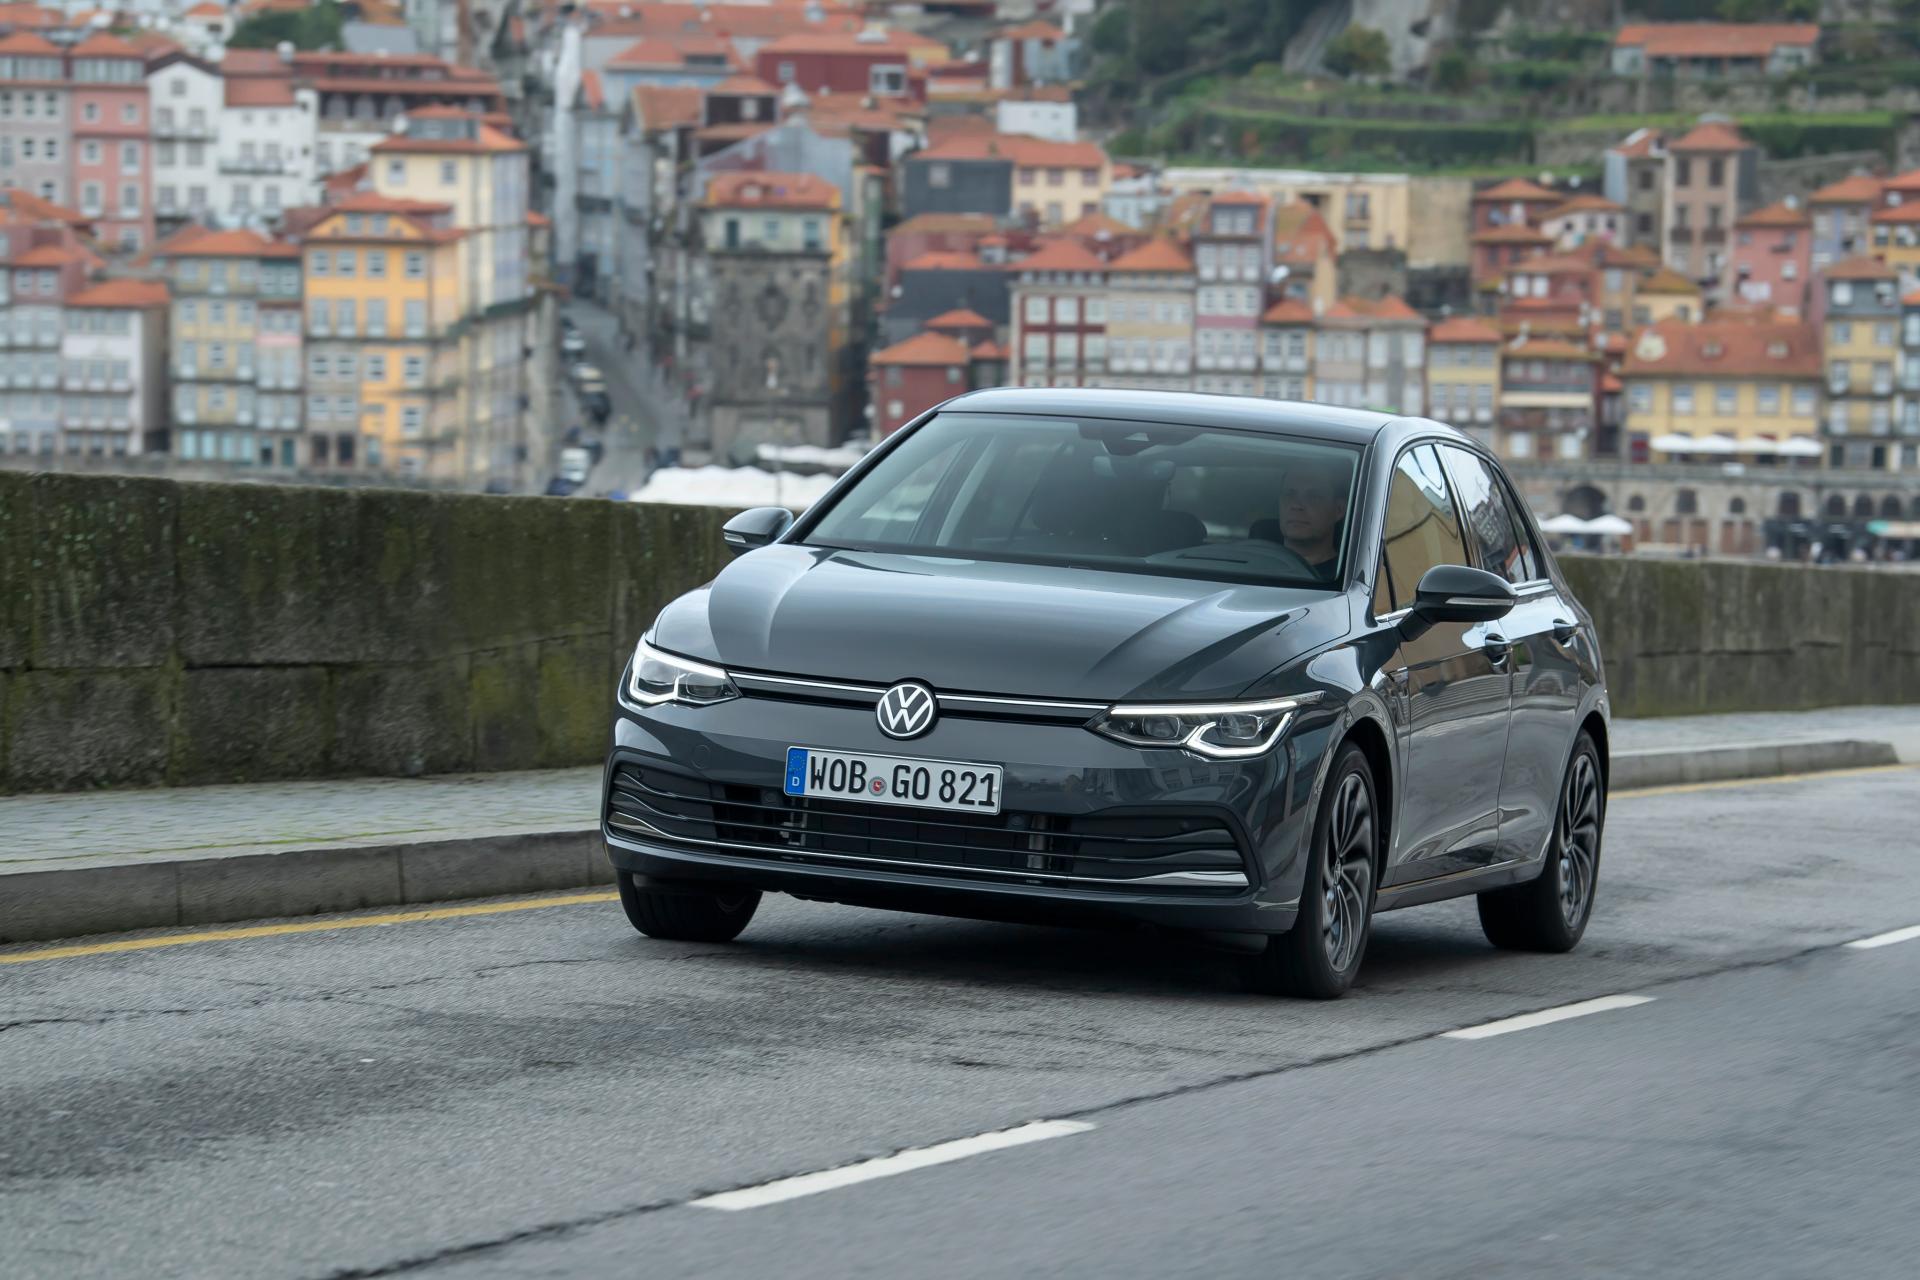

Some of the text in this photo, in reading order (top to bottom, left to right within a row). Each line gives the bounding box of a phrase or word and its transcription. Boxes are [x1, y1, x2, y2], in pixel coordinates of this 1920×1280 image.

[881, 685, 933, 734] VW
[791, 776, 800, 787] D
[810, 755, 995, 807] WOB GO 821
